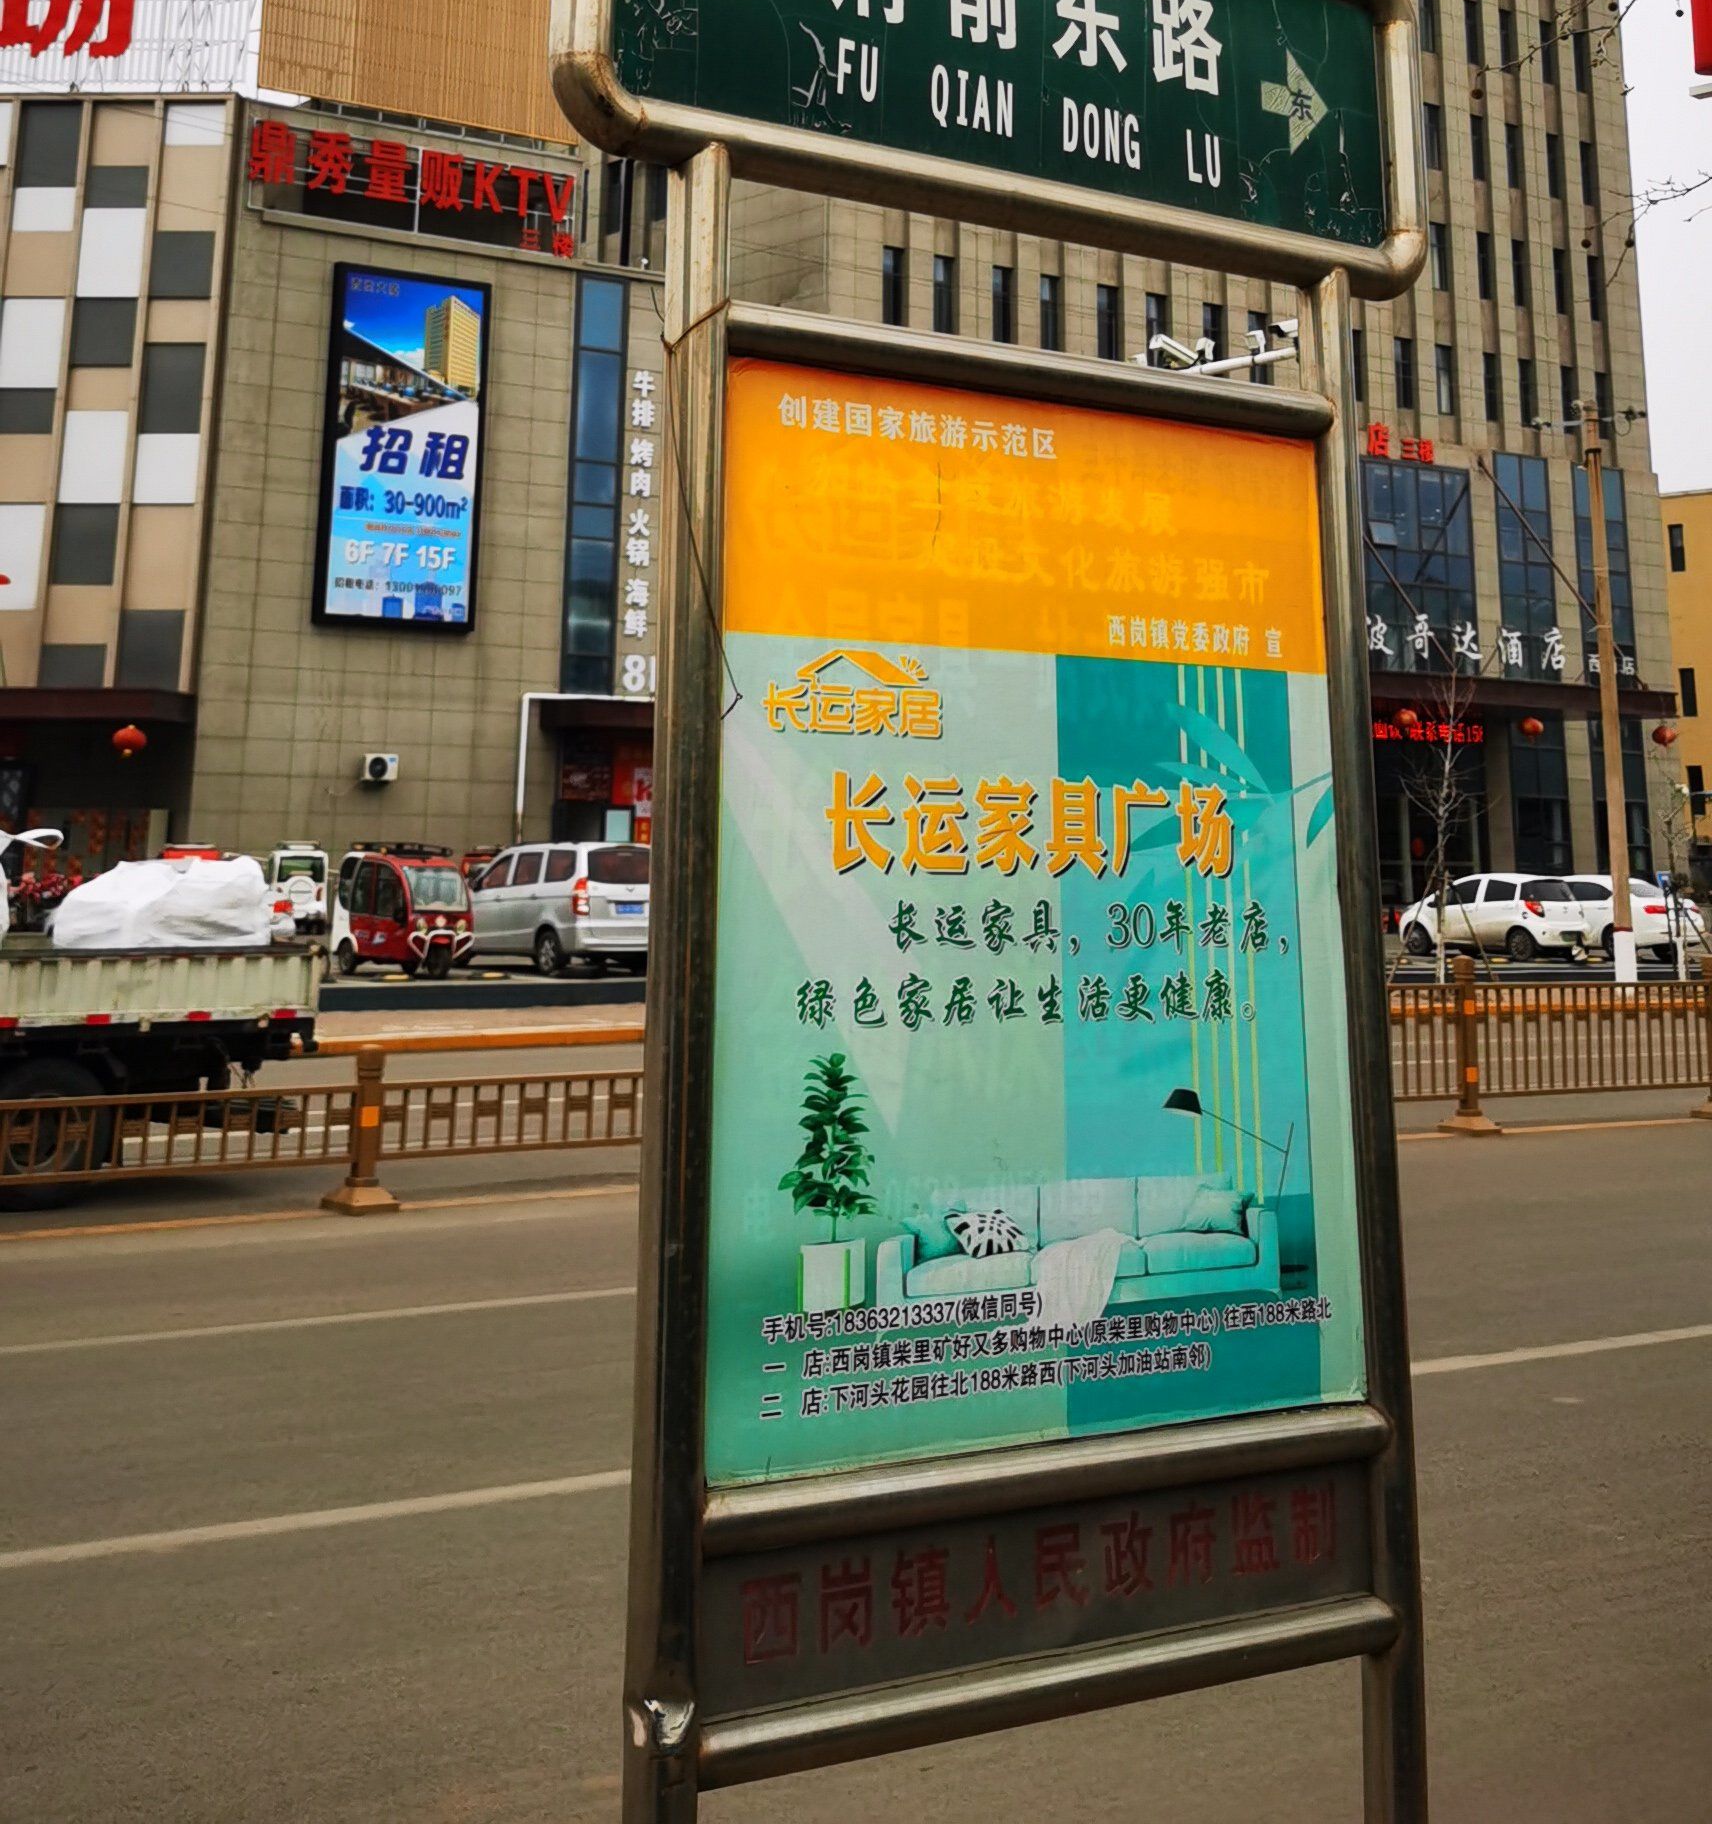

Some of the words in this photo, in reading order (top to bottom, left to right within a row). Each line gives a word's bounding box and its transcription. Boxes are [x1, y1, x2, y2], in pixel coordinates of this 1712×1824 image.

[836, 38, 879, 103] FU
[930, 62, 1014, 139] QIAN
[1062, 96, 1141, 171] DONG
[1186, 128, 1222, 189] LU
[1287, 87, 1314, 121] 东
[247, 120, 575, 224] 鼎秀量贩KTV
[520, 227, 574, 259] 三楼
[632, 371, 655, 428] 牛排
[778, 392, 1058, 460] 创建国家旅游示范区
[360, 425, 470, 480] 招租
[629, 438, 654, 497] 烤肉
[345, 539, 375, 564] 6F
[382, 542, 410, 567] 7F
[416, 545, 457, 570] 15F
[626, 508, 650, 567] 火锅
[623, 578, 649, 638] 海鲜
[1106, 614, 1250, 656] 西岗镇党委政府
[1265, 626, 1283, 658] 宣
[1365, 613, 1566, 670] 波哥达酒店
[763, 682, 943, 738] 长运家居
[826, 771, 1237, 879] 长运家具广场
[796, 969, 1258, 1026] 绿色家居让生活更健康。
[741, 1484, 1338, 1665] 西岗镇人民政府监制
